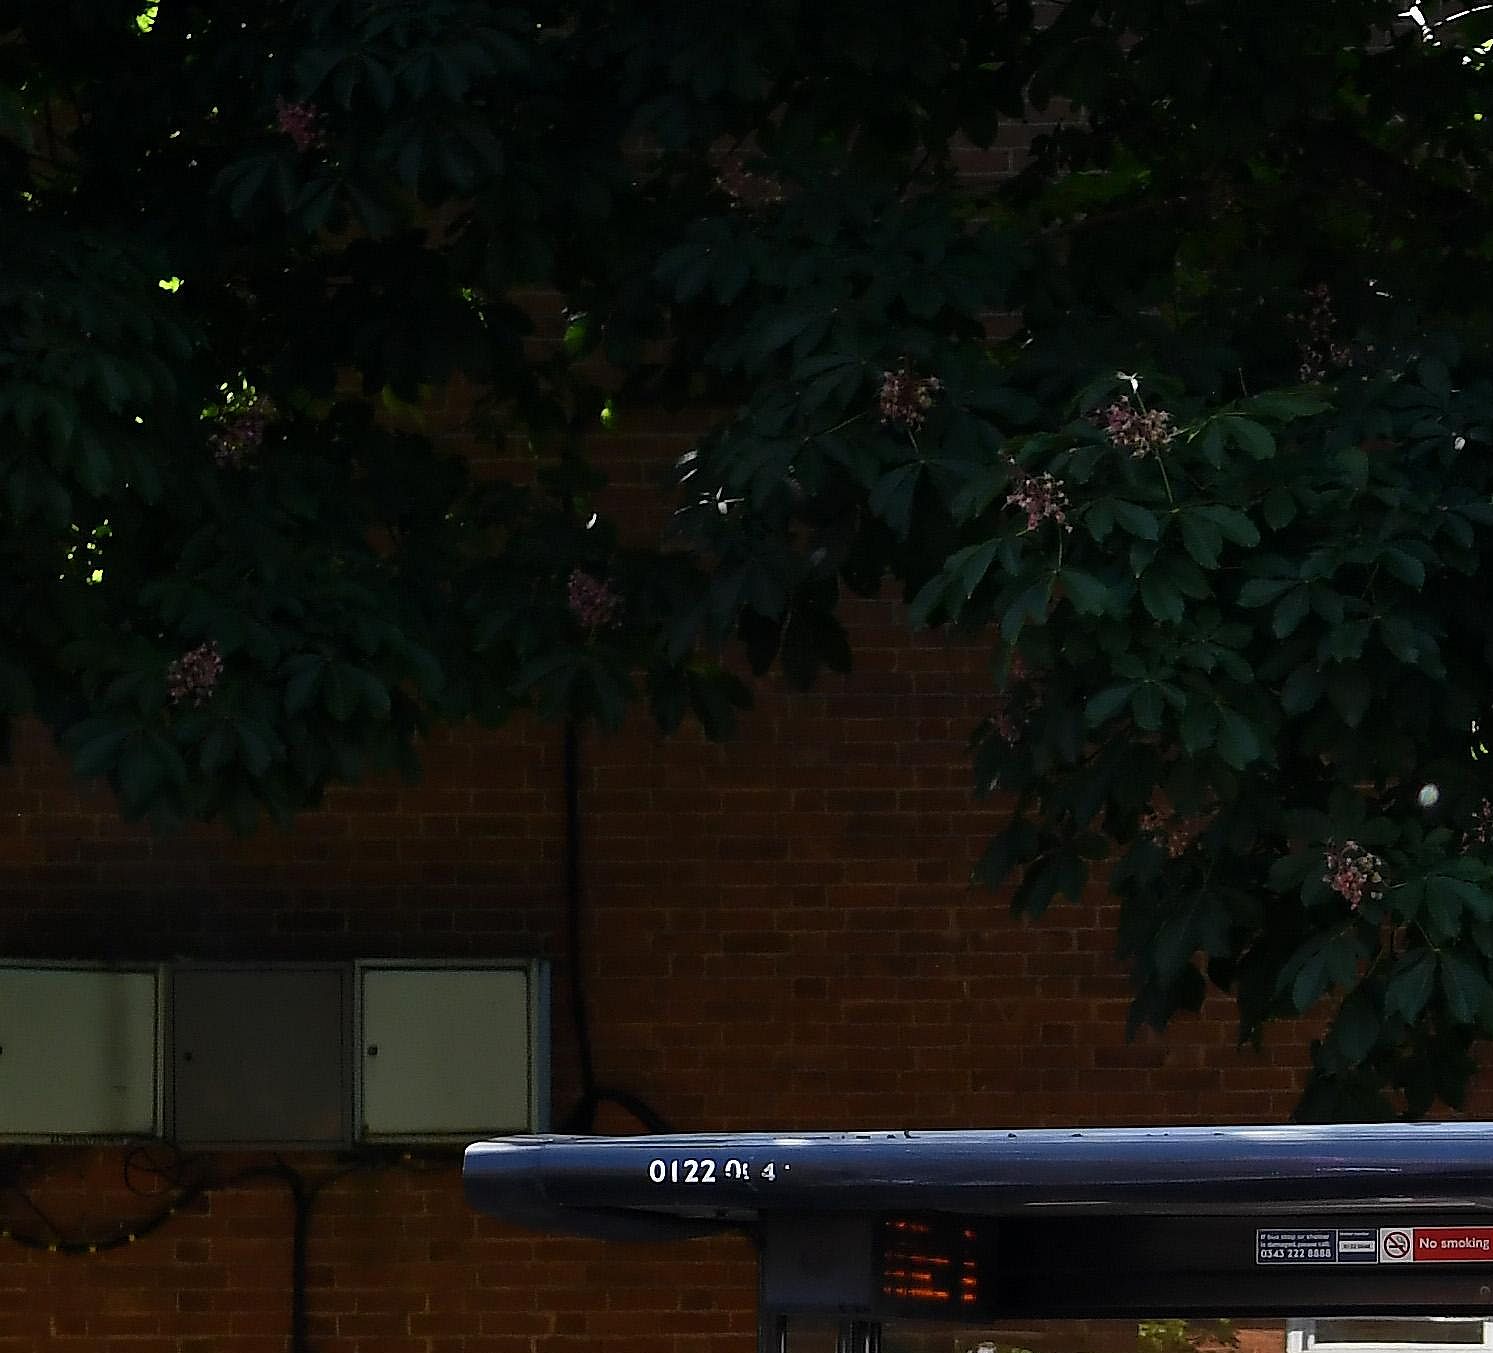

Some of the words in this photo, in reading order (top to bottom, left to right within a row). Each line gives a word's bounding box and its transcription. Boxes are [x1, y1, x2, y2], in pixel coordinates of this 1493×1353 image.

[650, 1160, 715, 1182] 0122
[1420, 1239, 1436, 1249] No
[1441, 1238, 1489, 1250] smoking
[1261, 1249, 1284, 1258] 0343
[1288, 1249, 1304, 1258] 222
[1307, 1249, 1331, 1257] 8888
